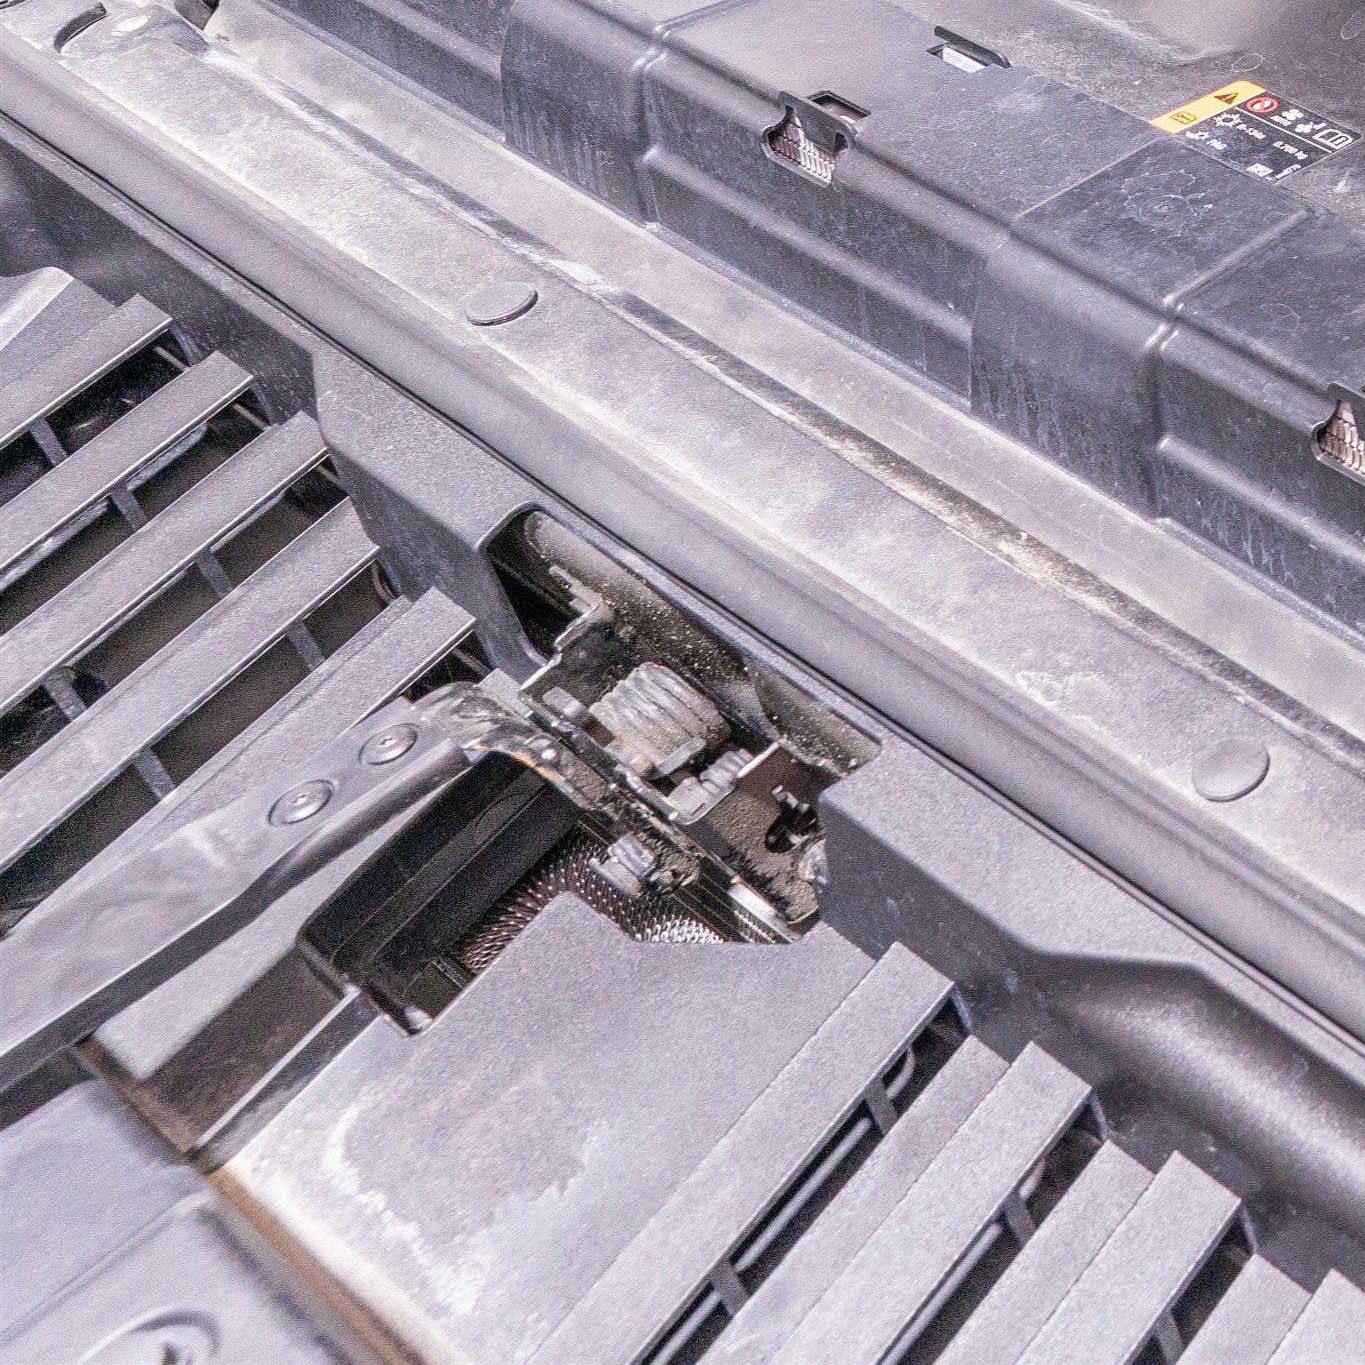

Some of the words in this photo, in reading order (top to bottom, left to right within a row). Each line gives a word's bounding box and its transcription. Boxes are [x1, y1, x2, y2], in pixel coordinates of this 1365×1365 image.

[1270, 115, 1292, 127] AUTO
[1205, 138, 1228, 151] PAG
[1235, 123, 1266, 141] R-134a
[1294, 150, 1308, 161] kg
